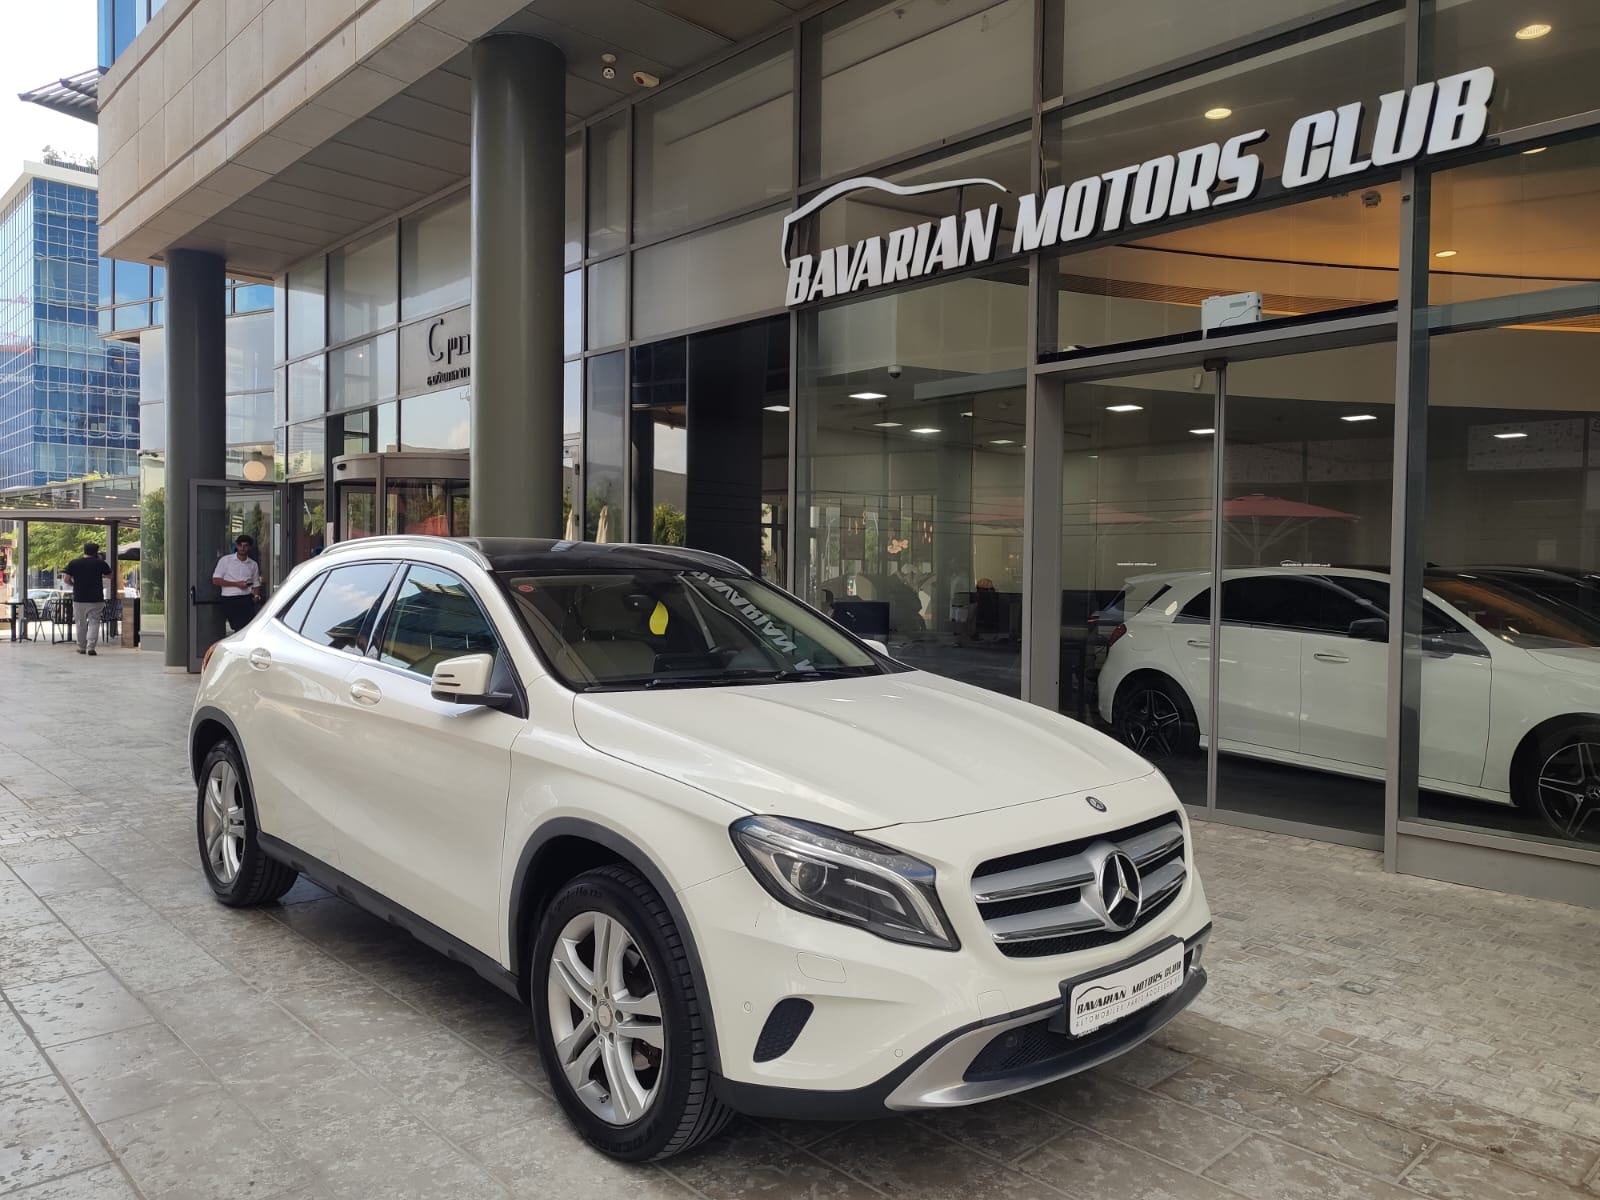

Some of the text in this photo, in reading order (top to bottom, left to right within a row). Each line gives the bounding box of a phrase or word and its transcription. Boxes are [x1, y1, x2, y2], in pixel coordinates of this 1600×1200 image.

[785, 66, 1495, 307] BAVARIAN MOTORS CLUB
[428, 318, 444, 362] C
[1077, 961, 1181, 1015] BAVARIAN MOTORS CLUB
[1075, 1003, 1125, 1027] AUTOMOBILES
